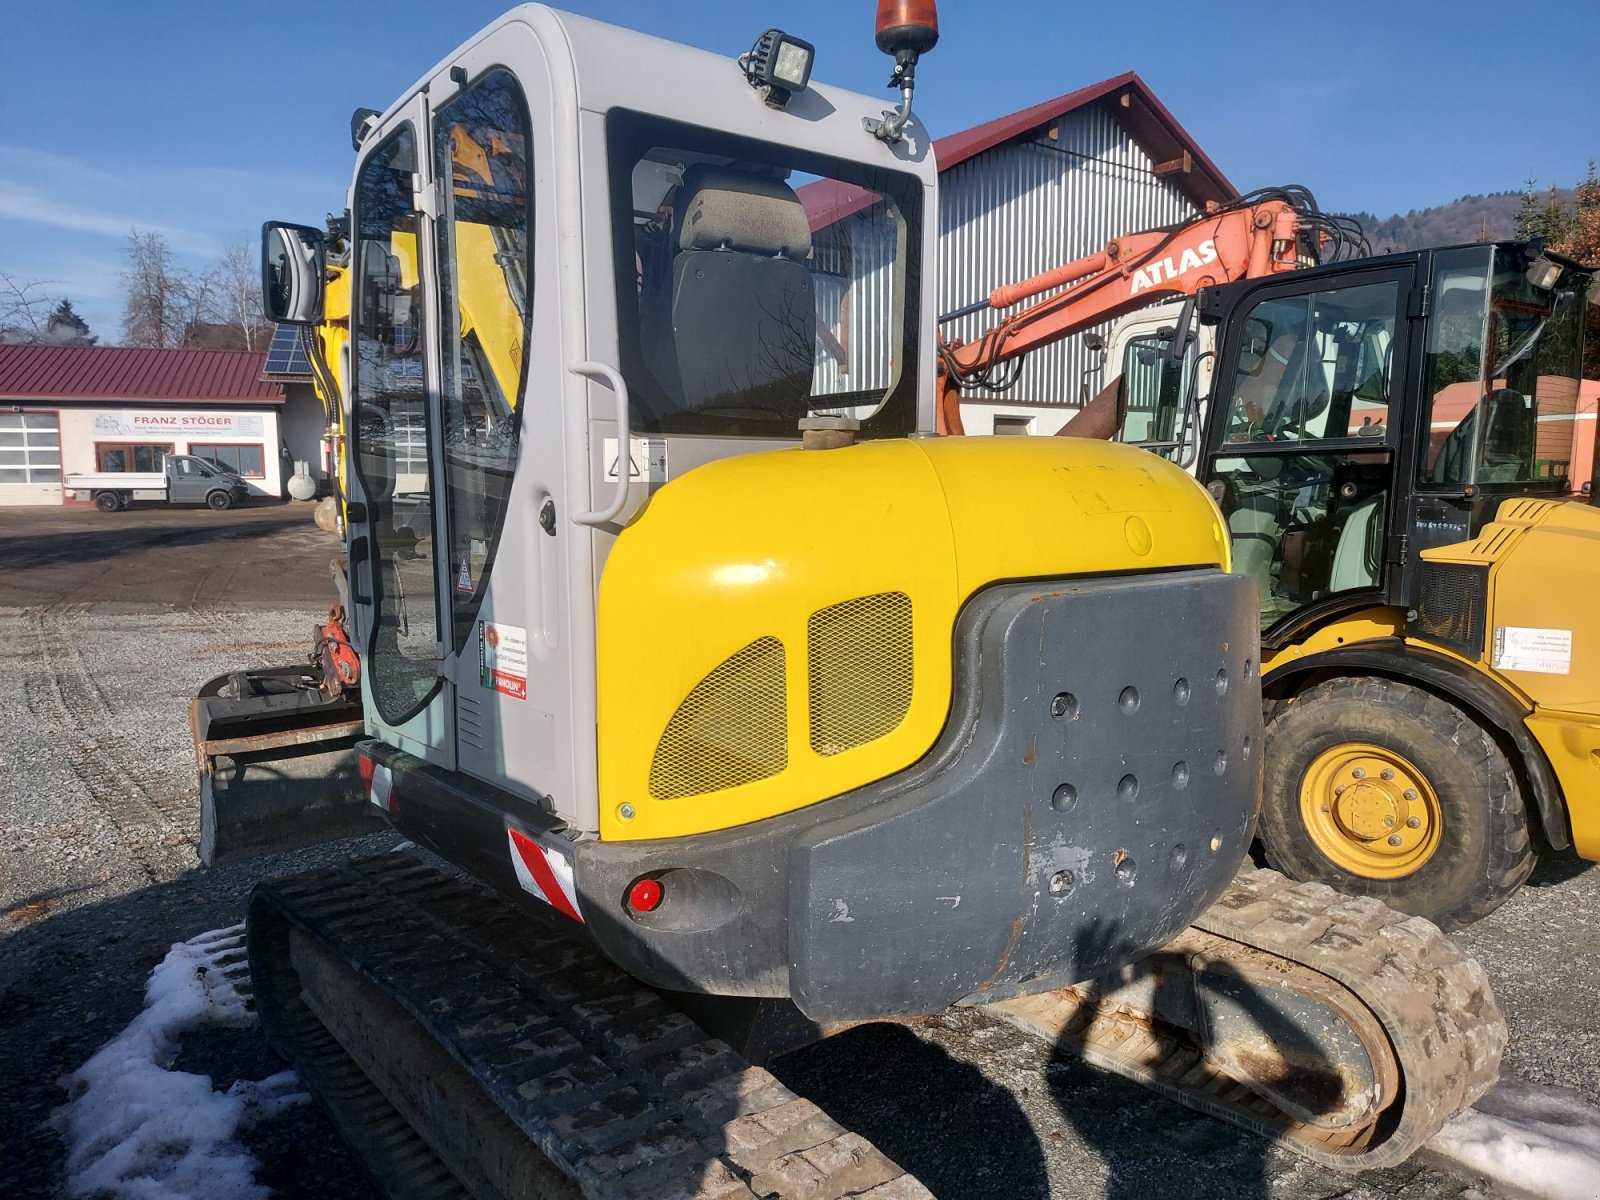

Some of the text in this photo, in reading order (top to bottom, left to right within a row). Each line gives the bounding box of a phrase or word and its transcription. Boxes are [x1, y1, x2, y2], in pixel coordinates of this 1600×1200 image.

[1130, 240, 1217, 295] ATLAS
[134, 416, 232, 425] FRANZ STÖGER
